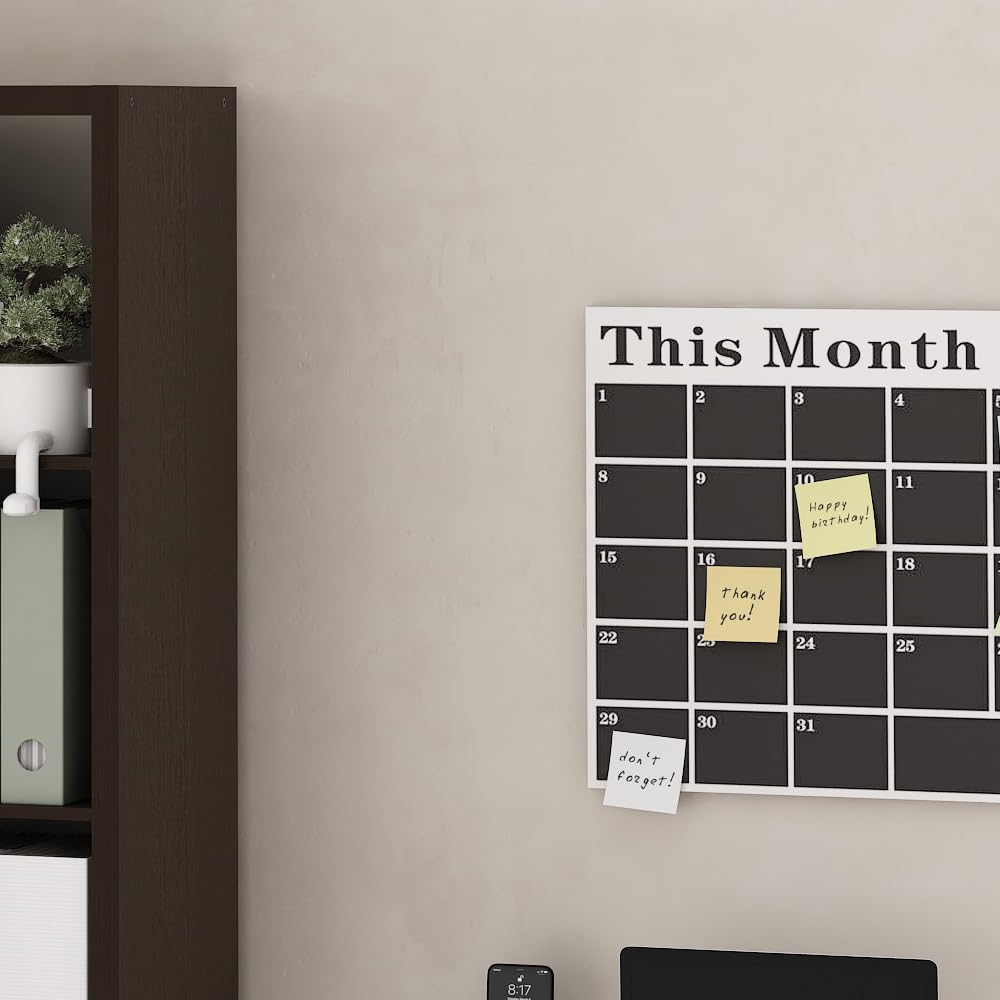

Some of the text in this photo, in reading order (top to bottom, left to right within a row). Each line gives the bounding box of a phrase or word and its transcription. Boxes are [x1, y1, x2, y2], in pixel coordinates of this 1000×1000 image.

[600, 325, 981, 371] This Month
[598, 389, 608, 402] 1
[696, 390, 706, 404] 2
[795, 391, 805, 405] 3
[894, 393, 905, 407] 4
[598, 470, 914, 489] 8 9 10 11
[809, 502, 847, 512] Happy
[812, 506, 869, 528] birthday!
[599, 551, 618, 564] 15
[697, 553, 716, 566] 16
[896, 558, 916, 571] 18
[720, 603, 755, 626] you!
[598, 631, 618, 645] 22
[796, 636, 816, 650] 24
[896, 639, 916, 653] 25
[599, 712, 816, 732] 29 30 31
[619, 751, 661, 765] don't
[618, 771, 675, 790] forget!
[507, 983, 532, 996] 8:17
